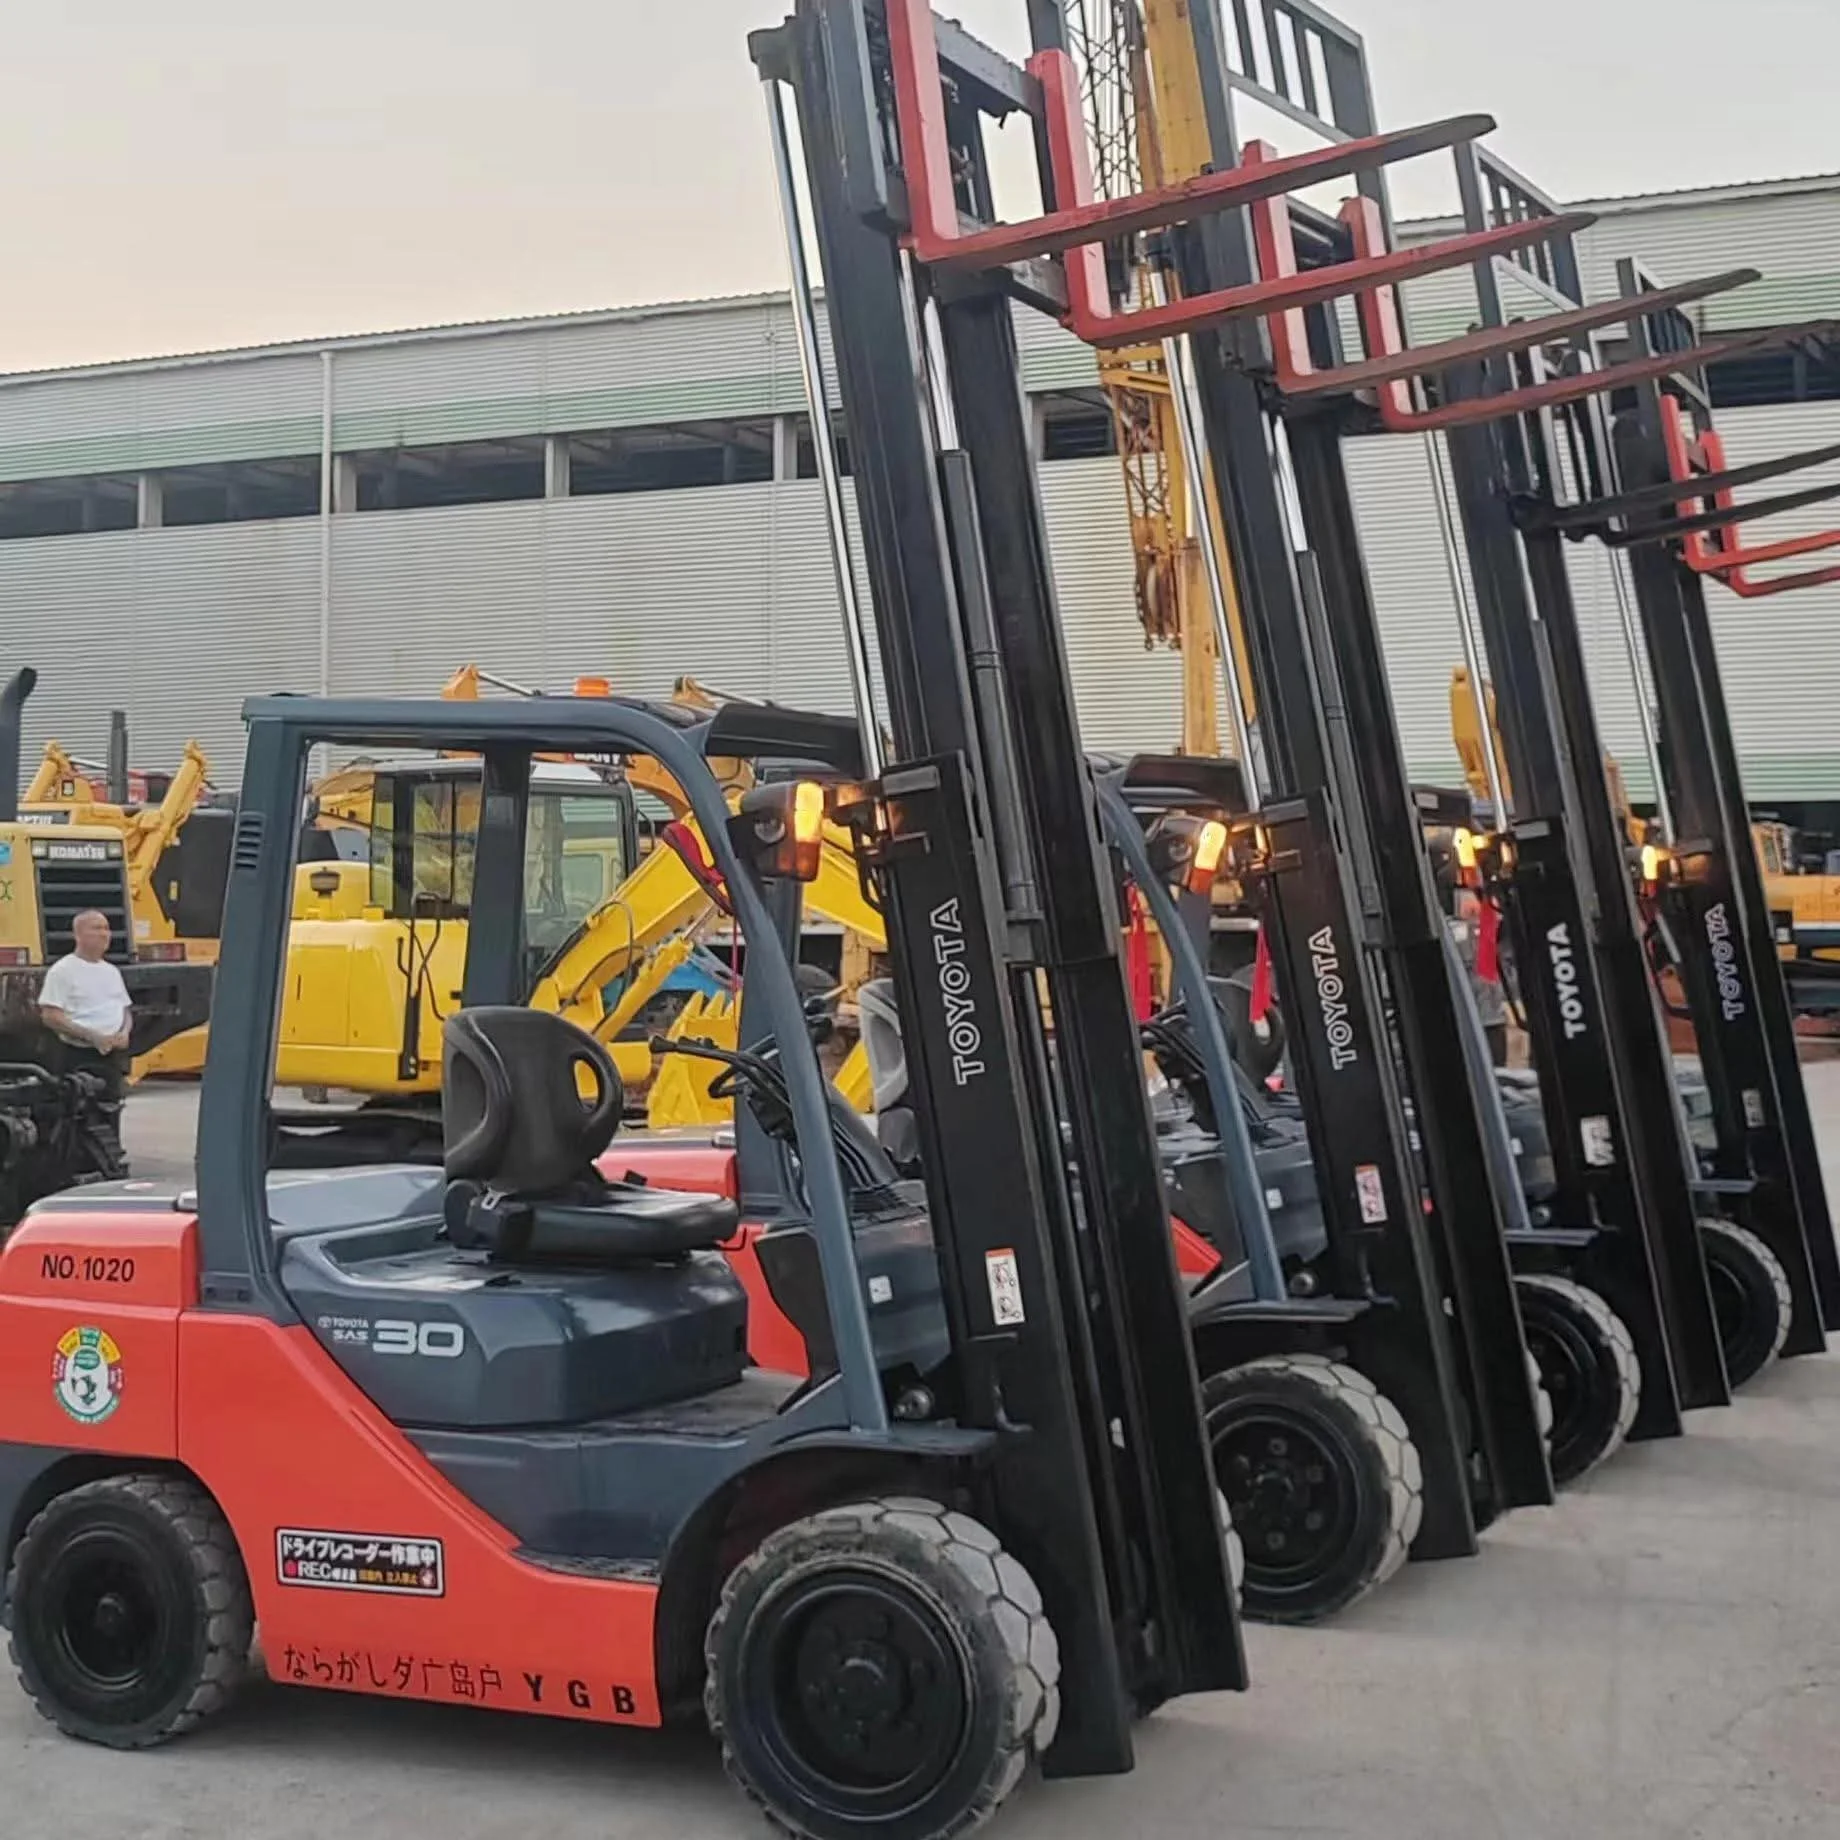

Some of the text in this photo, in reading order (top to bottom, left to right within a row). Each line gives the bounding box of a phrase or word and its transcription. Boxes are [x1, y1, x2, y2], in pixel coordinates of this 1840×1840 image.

[929, 897, 985, 1085] TOYOTA
[1308, 925, 1357, 1071] TOYOTA
[1546, 922, 1586, 1039] TOYOTA
[1704, 903, 1744, 1020] TOYOTA
[332, 1329, 369, 1341] SAS
[332, 1317, 464, 1357] TOYOTA 30
